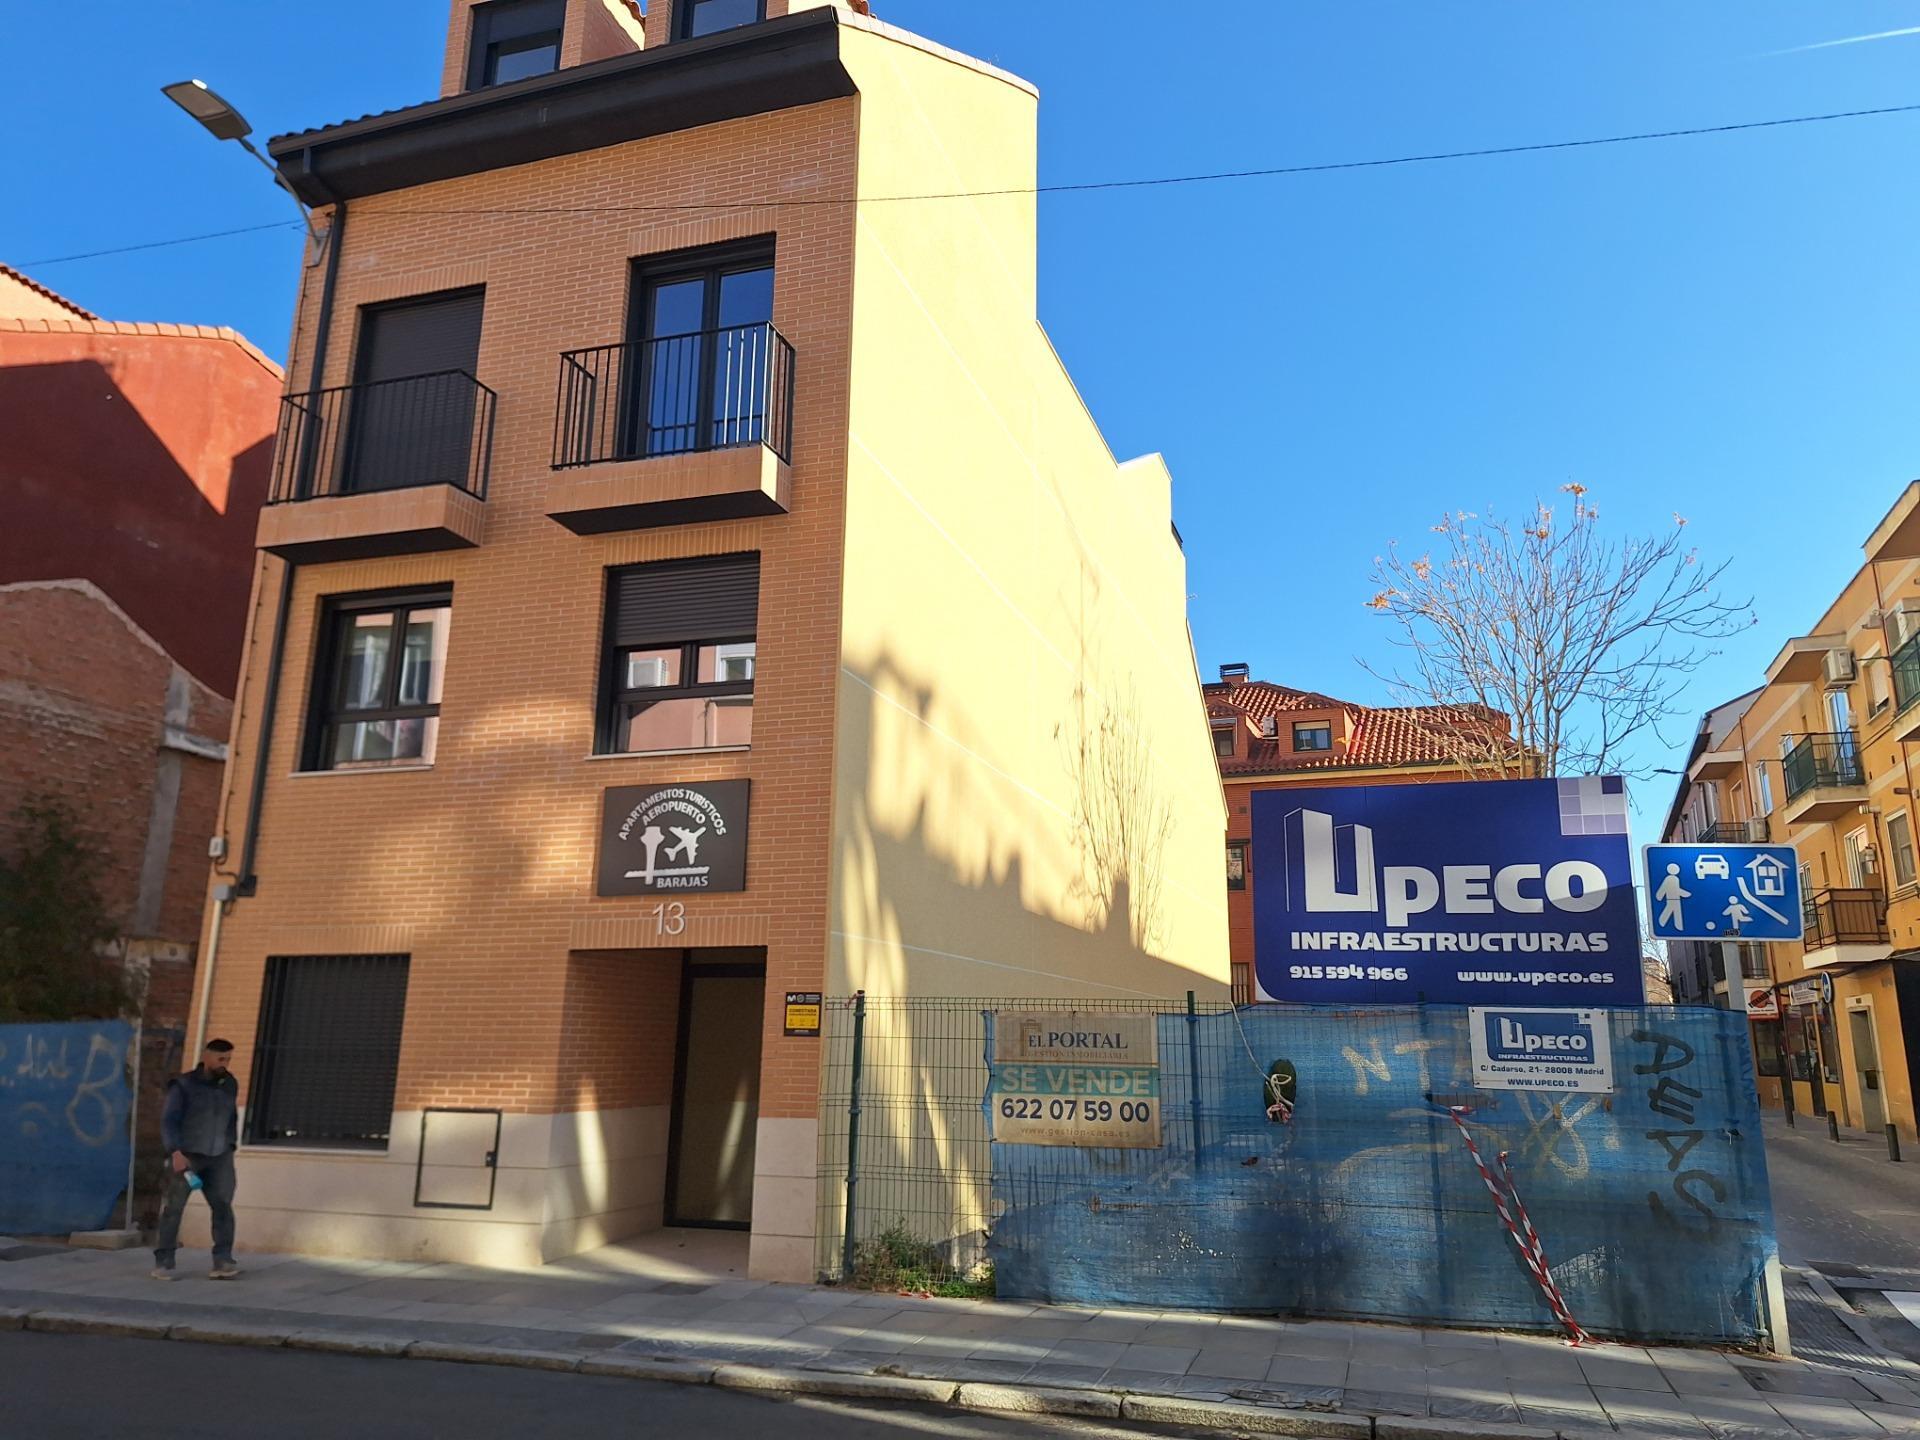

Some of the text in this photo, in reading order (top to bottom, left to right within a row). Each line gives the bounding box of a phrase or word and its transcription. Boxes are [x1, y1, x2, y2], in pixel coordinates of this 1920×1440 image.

[618, 788, 727, 841] APARTAMENTOS TURISTICOS
[642, 801, 706, 826] AEROPUERTO
[656, 876, 709, 888] BARAJAS
[652, 902, 686, 935] 13
[1290, 931, 1609, 952] INFRAESTRUCTURAS
[1289, 963, 1614, 986] 915 594 966 www.upeco.es
[1028, 1031, 1129, 1050] EL PORTAL
[1498, 1053, 1588, 1061] INFRAESTRUCTURAS
[1491, 1065, 1525, 1073] Cadarso,
[1002, 1067, 1150, 1095] SE VENDE
[1507, 1078, 1579, 1087] WWW.UPECO.ES
[1001, 1098, 1150, 1123] 622 07 59 00
